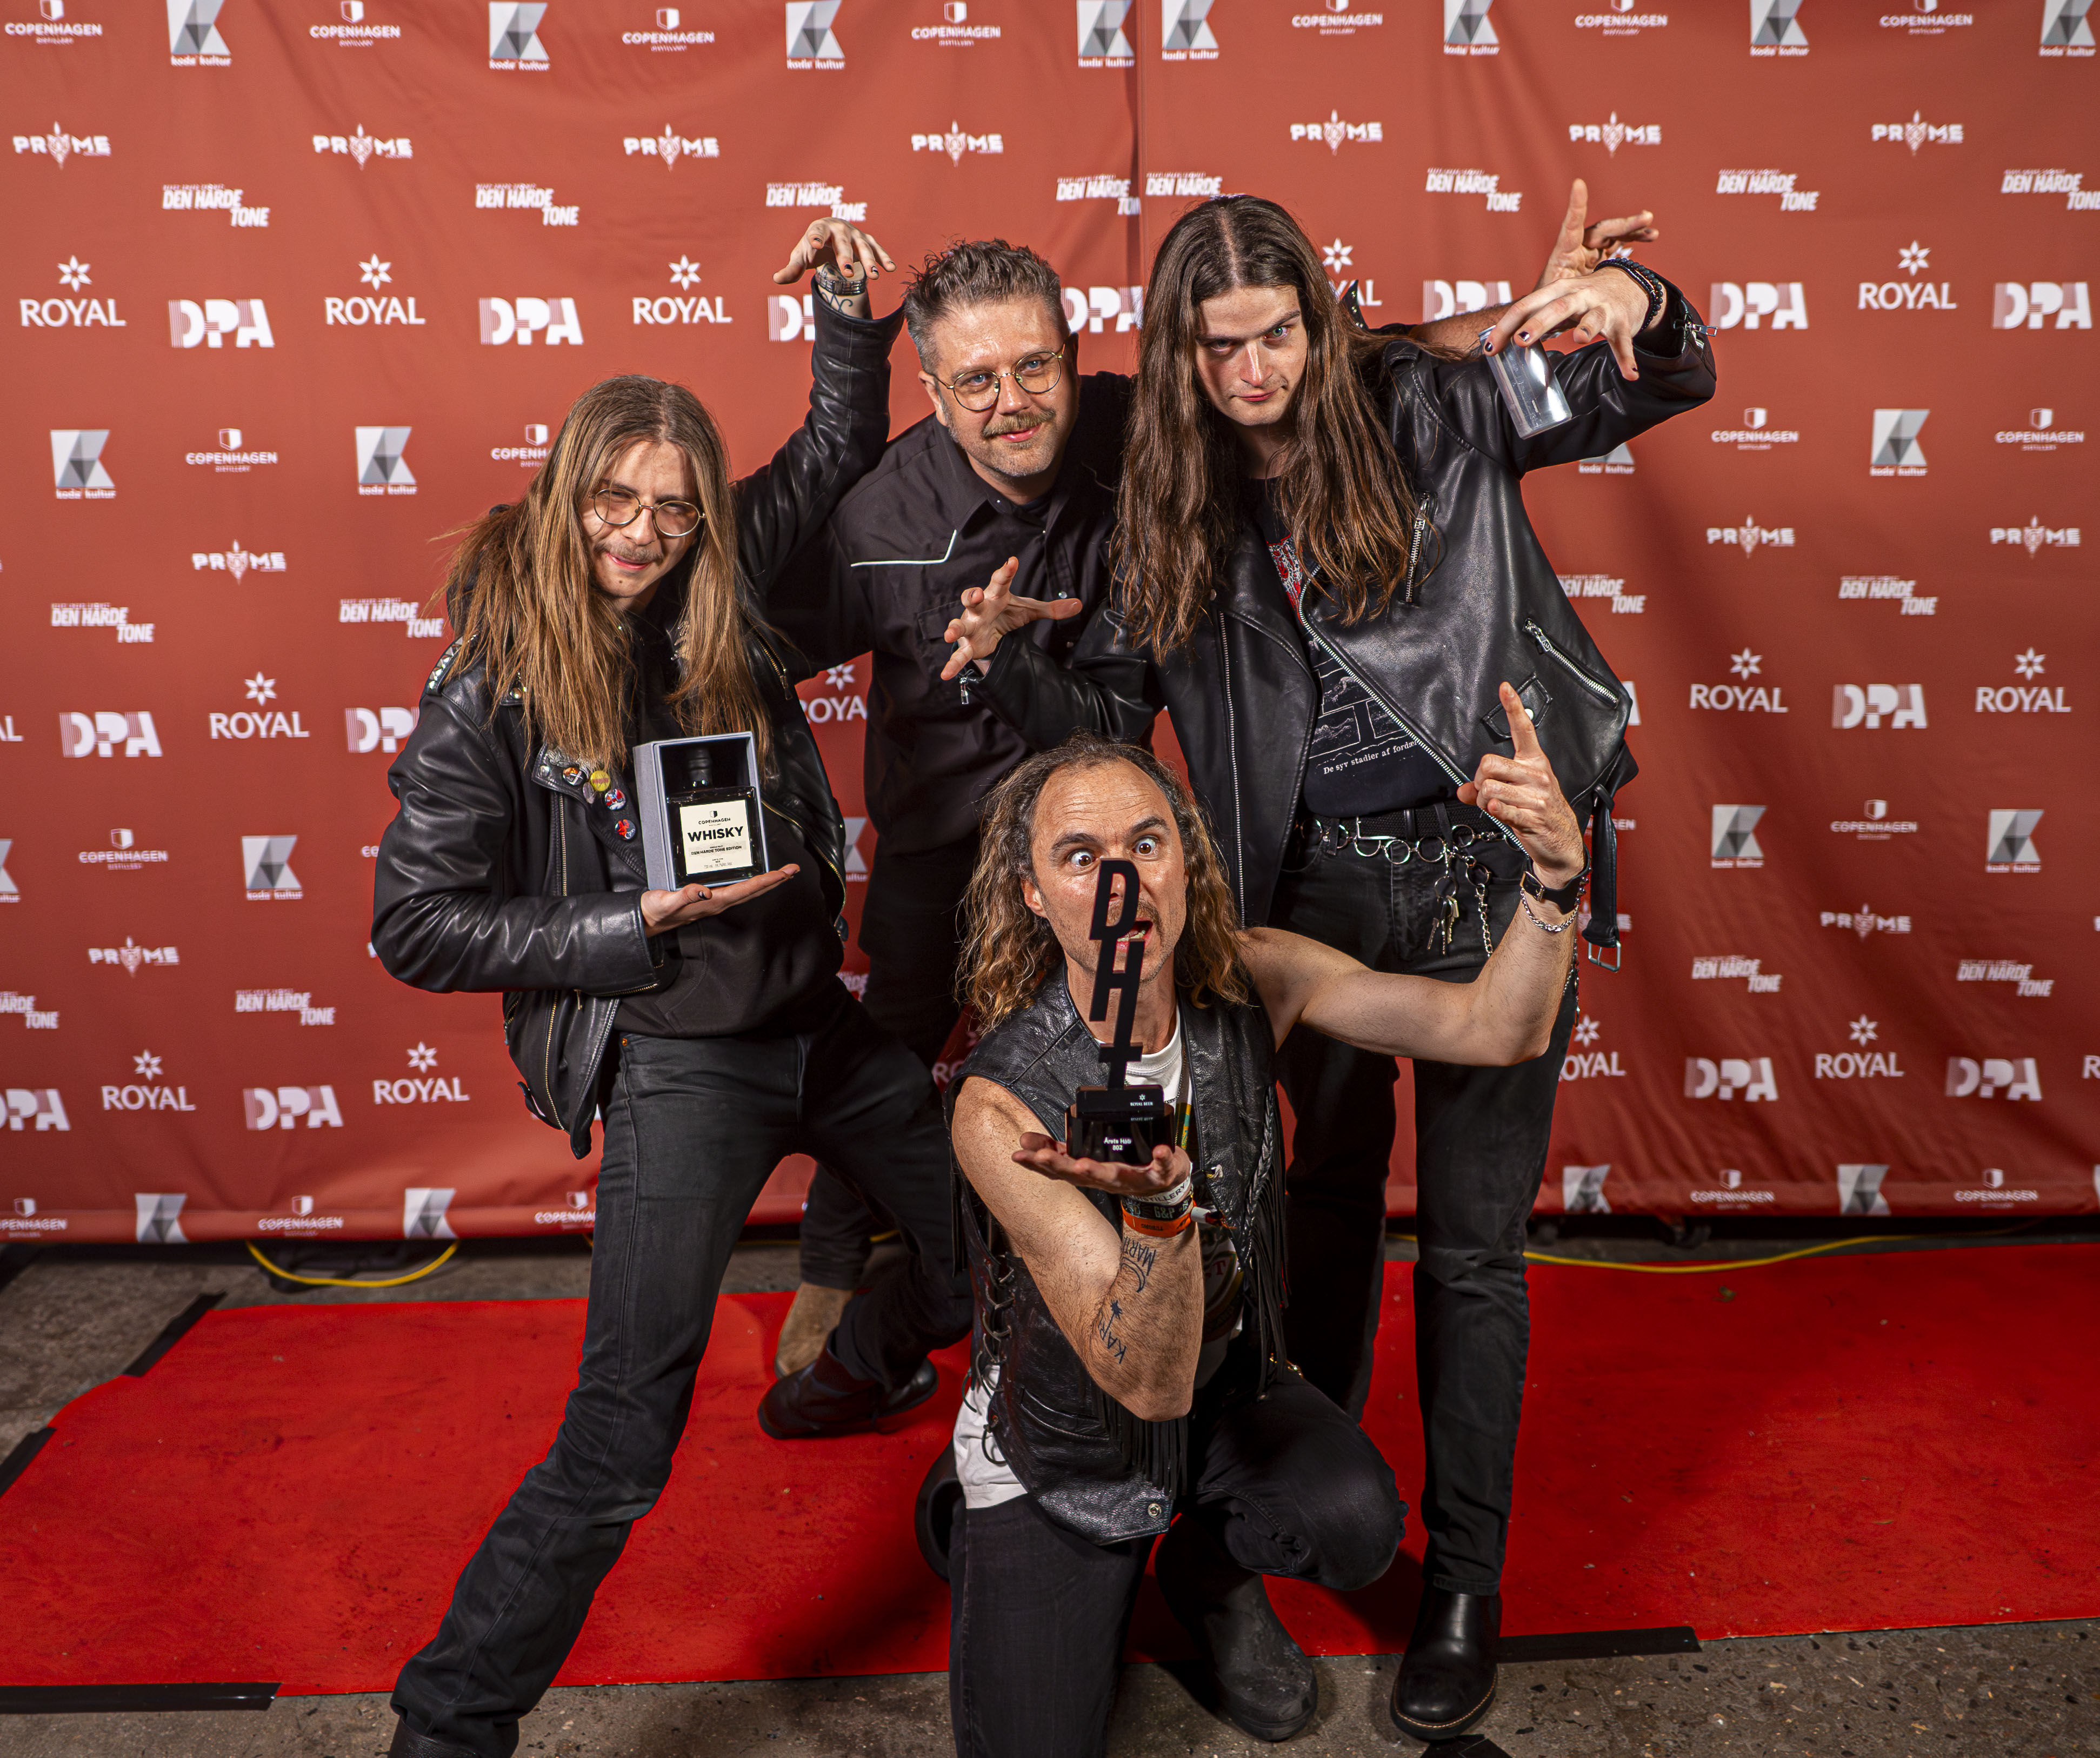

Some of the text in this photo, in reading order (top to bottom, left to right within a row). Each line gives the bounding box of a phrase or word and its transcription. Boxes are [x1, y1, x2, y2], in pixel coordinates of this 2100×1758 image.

[4, 23, 103, 36] COPENHAGEN
[1291, 14, 1383, 28] COPENHAGEN
[1575, 15, 1668, 28] COPENHAGEN
[1879, 14, 1973, 28] COPENHAGEN
[309, 25, 401, 38] COPENHAGEN
[622, 31, 715, 44] COPENHAGEN
[911, 26, 1001, 40] COPENHAGEN
[1056, 180, 1086, 202] DEN
[1145, 178, 1175, 196] DEN
[1425, 174, 1454, 193] DEN
[1716, 174, 1748, 194] DEN
[2001, 174, 2033, 193] DEN
[162, 189, 194, 210] DEN
[475, 189, 505, 209] DEN
[765, 188, 796, 207] DEN
[1486, 192, 1522, 212] TONE
[1780, 191, 1819, 211] TONE
[230, 207, 270, 228] TONE
[542, 206, 580, 226] TONE
[1710, 282, 1809, 329] DPA
[1857, 282, 1957, 310] ROYAL
[1993, 282, 2092, 330] DPA
[19, 298, 127, 327] ROYAL
[324, 296, 426, 325] ROYAL
[632, 296, 733, 325] ROYAL
[168, 298, 275, 349] DPA
[478, 297, 584, 346] DPA
[1711, 430, 1799, 443] COPENHAGEN
[1995, 431, 2084, 443] COPENHAGEN
[185, 452, 278, 465] COPENHAGEN
[491, 447, 548, 460] COPENH
[1838, 581, 1869, 599] DEN
[339, 603, 370, 623] DEN
[1611, 595, 1646, 614] TONE
[1901, 597, 1938, 616] TONE
[51, 607, 81, 627] DEN
[116, 623, 155, 643] TONE
[407, 618, 444, 638] TONE
[1689, 684, 1788, 713] ROYAL
[1832, 683, 1928, 729] DPA
[1975, 686, 2072, 713] ROYAL
[59, 711, 163, 758] DPA
[209, 711, 310, 739] ROYAL
[345, 707, 420, 753] DP
[1323, 767, 1334, 775] De
[1336, 761, 1348, 772] syv
[1351, 752, 1379, 766] stadier
[1382, 747, 1390, 758] af
[688, 826, 743, 842] WHISKY
[1830, 821, 1917, 833] COPENHAGEN
[78, 850, 169, 864] COPENHAGEN
[1691, 960, 1718, 979] DEN
[1957, 965, 1986, 981] DEN
[1748, 974, 1782, 993] TONE
[2017, 979, 2054, 997] TONE
[235, 993, 265, 1012] DEN
[24, 1011, 58, 1029] TONE
[300, 1007, 336, 1026] TONE
[1561, 1051, 1626, 1081] OYAL
[1815, 1052, 1904, 1079] ROYAL
[1684, 1057, 1778, 1102] DPA
[1945, 1058, 2043, 1102] DPA
[101, 1085, 195, 1111] ROYAL
[373, 1077, 470, 1105] ROYAL
[244, 1085, 343, 1131] DPA
[1690, 1191, 1774, 1202] COPENHAGEN
[1955, 1190, 2038, 1202] COPENHAGEN
[258, 1217, 344, 1231] COPENHAGEN
[535, 1211, 596, 1225] COPENHA
